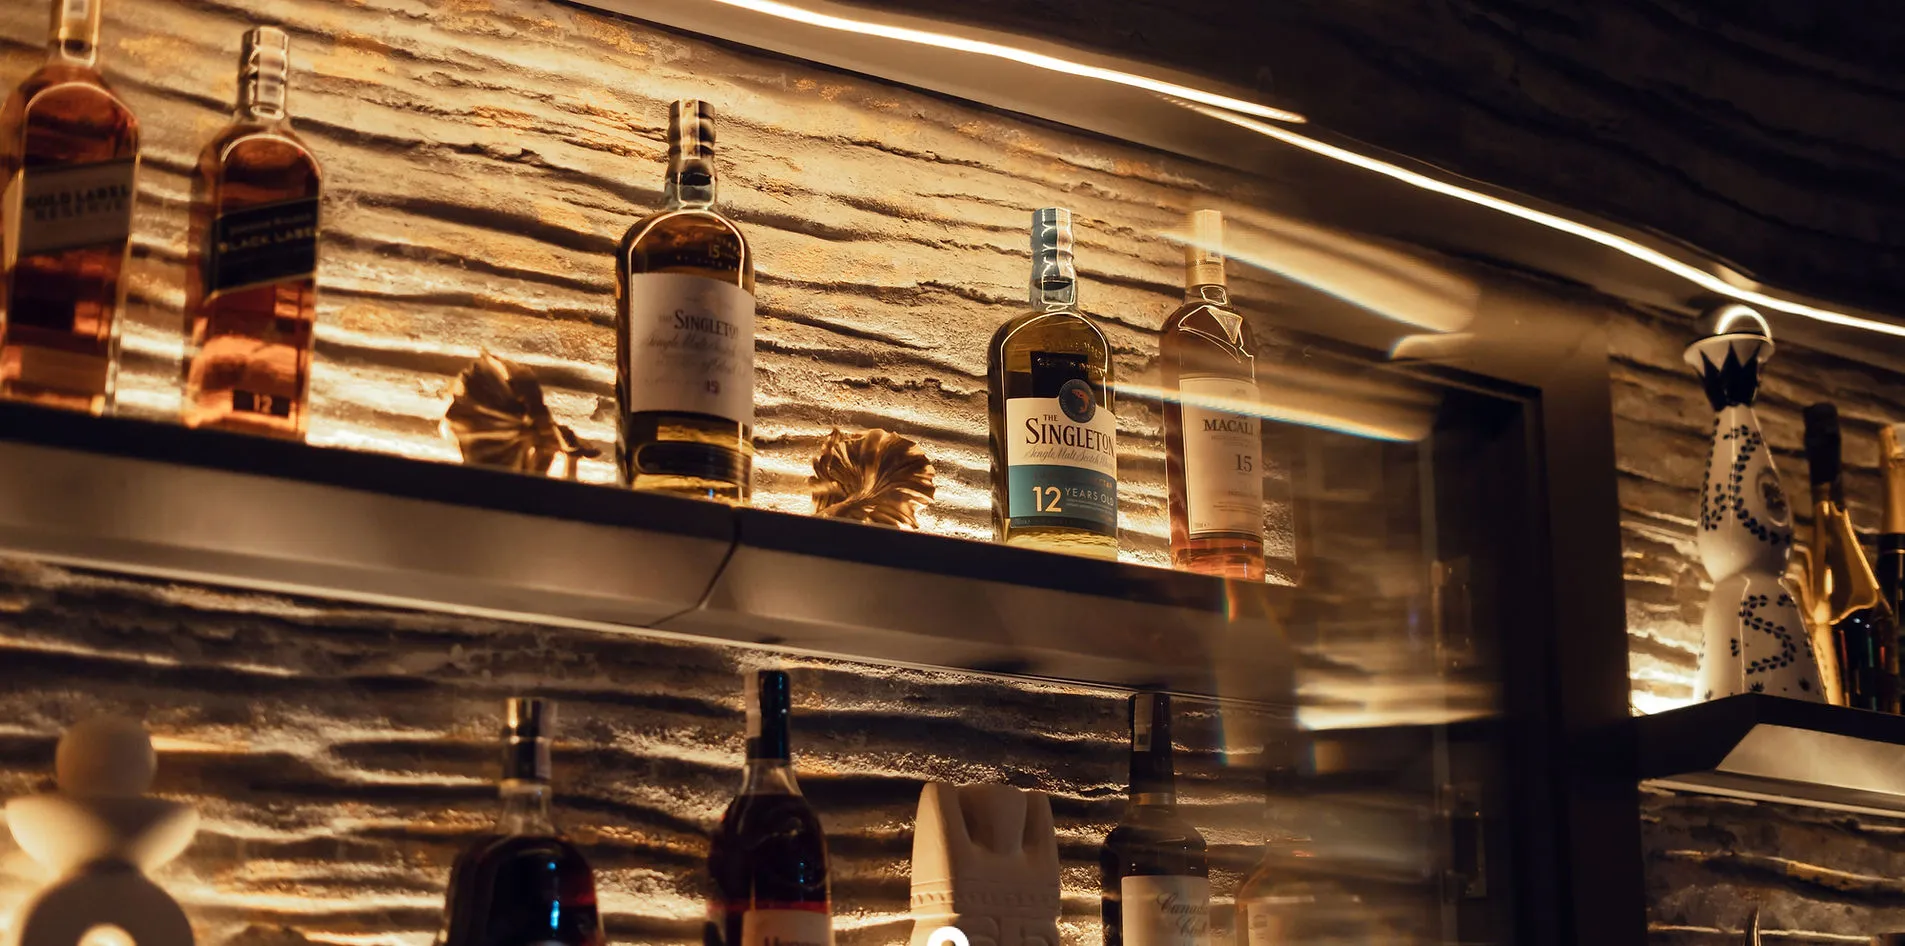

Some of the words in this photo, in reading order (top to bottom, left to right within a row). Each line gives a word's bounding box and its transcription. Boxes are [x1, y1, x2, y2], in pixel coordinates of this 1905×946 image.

[218, 235, 271, 253] BLACK
[708, 243, 721, 259] 15
[253, 393, 272, 414] 12
[1043, 414, 1058, 422] THE
[1025, 417, 1115, 458] SINGLETON
[1023, 446, 1056, 461] Single
[1056, 447, 1078, 461] Malt
[1235, 453, 1253, 473] 15
[1032, 486, 1062, 513] 12
[1065, 487, 1099, 501] YEARS
[1100, 493, 1115, 506] OLD
